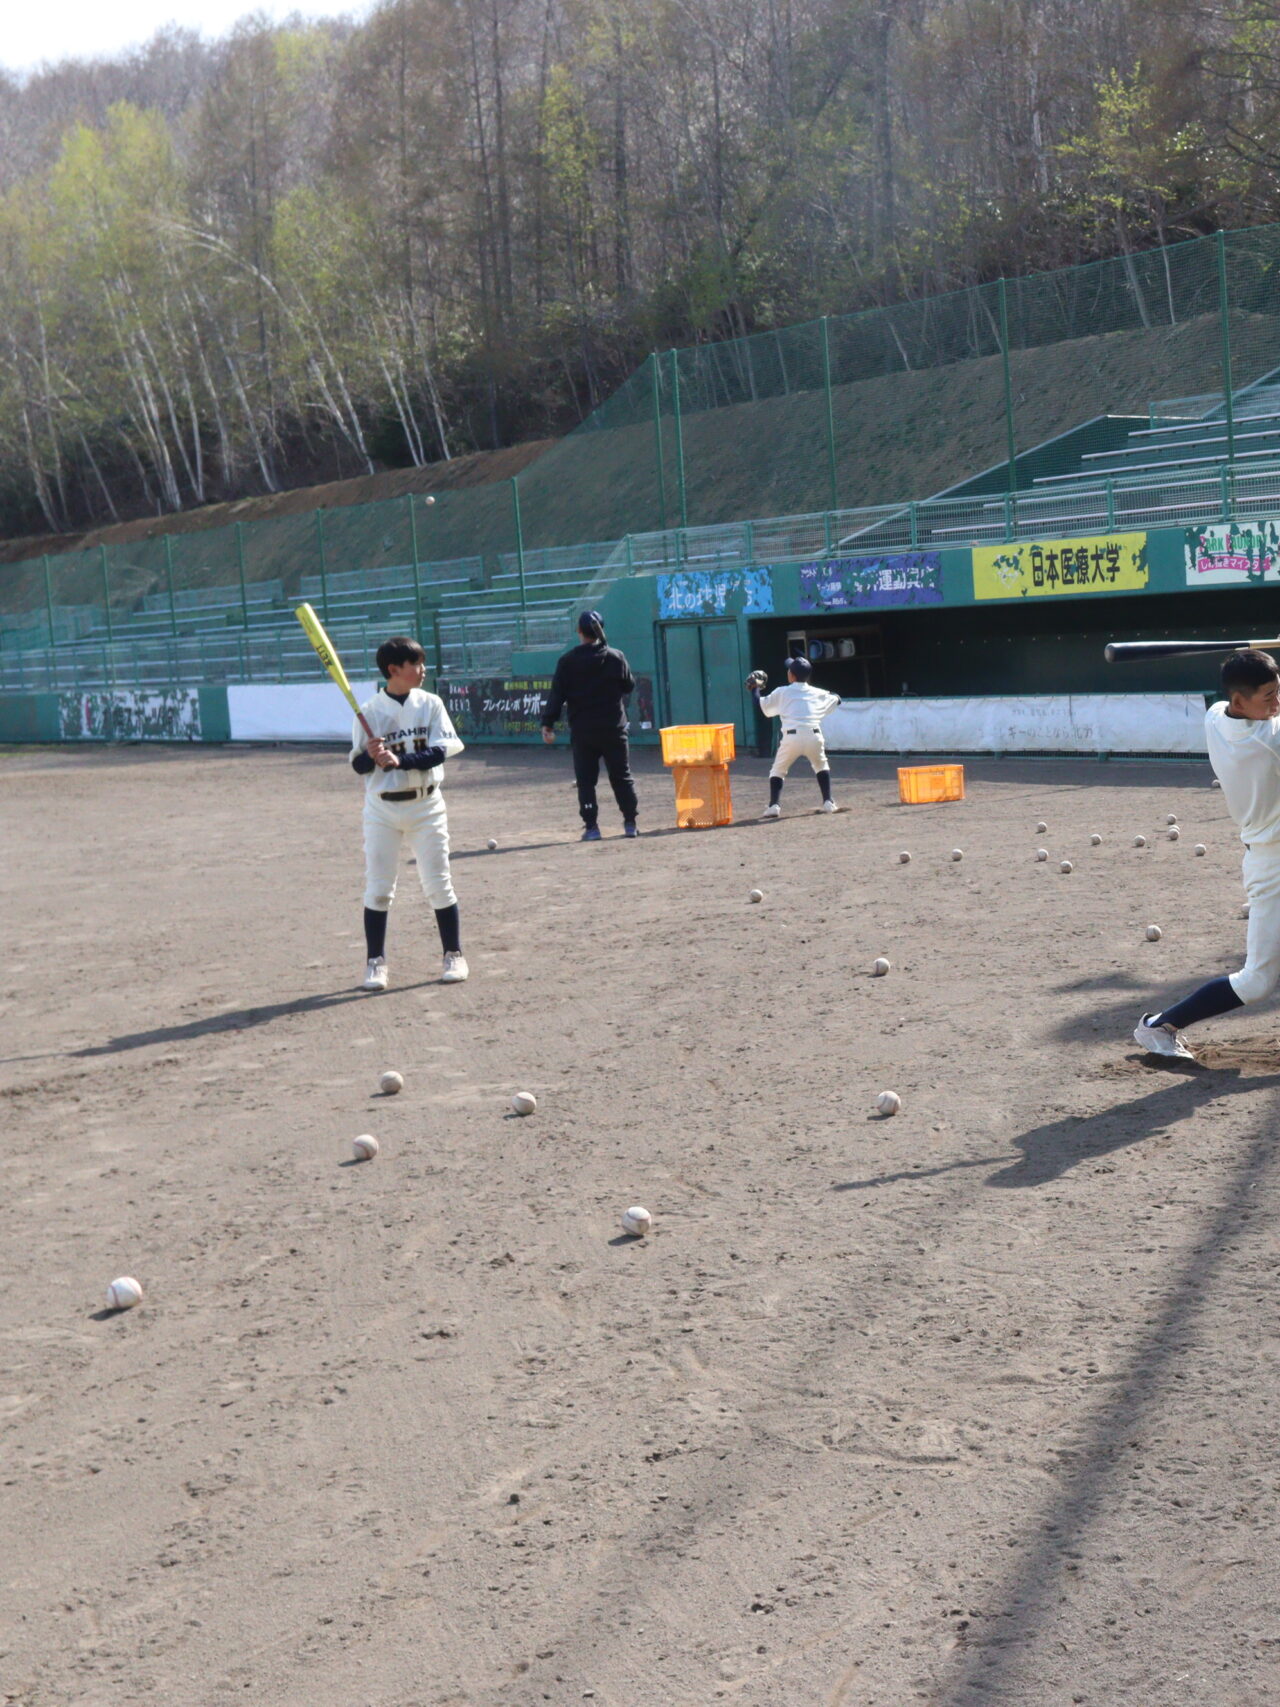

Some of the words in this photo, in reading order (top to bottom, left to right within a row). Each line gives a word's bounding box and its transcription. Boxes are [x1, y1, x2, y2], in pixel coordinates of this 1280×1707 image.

[1032, 542, 1120, 589] 日本医療大学
